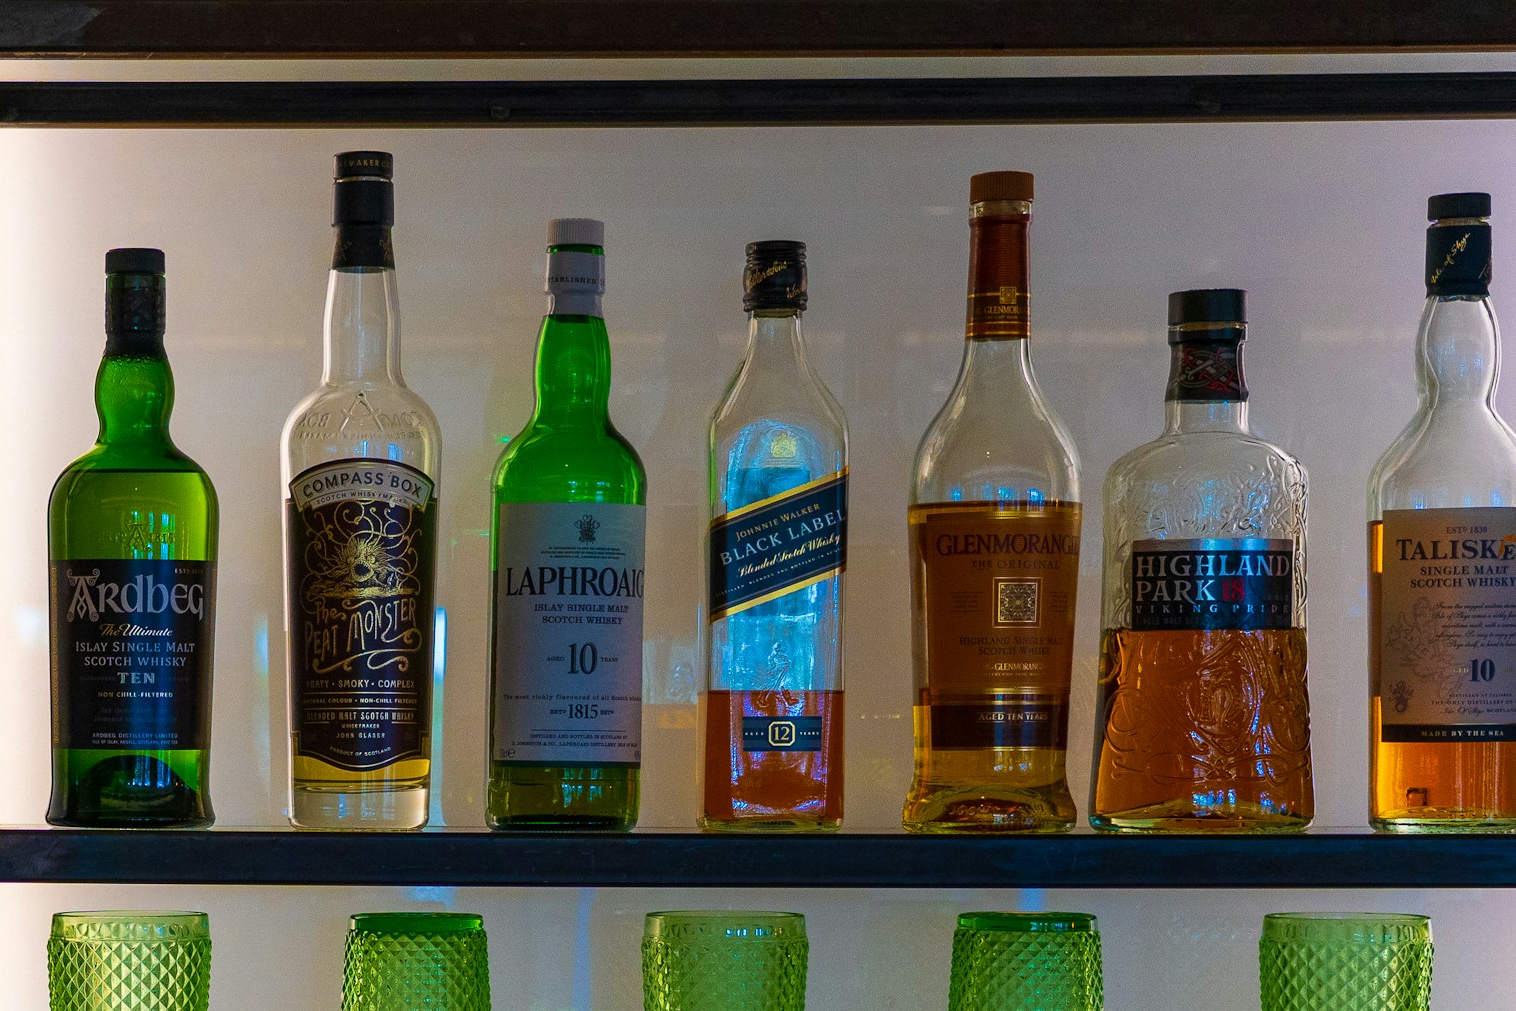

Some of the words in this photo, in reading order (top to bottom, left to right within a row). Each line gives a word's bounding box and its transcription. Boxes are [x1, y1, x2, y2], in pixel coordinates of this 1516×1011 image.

[302, 472, 383, 499] COMPASS
[390, 475, 422, 498] BOX
[736, 518, 780, 542] JOHNNIE
[780, 503, 820, 523] WALKER
[720, 532, 782, 566] BLACK
[790, 508, 846, 540] LABEL
[736, 552, 776, 578] Blended
[776, 543, 807, 566] Scotch
[806, 532, 841, 552] Whisky
[1396, 539, 1516, 561] TALISKE
[972, 560, 993, 569] THE
[997, 560, 1060, 570] ORIGINAL
[1136, 555, 1291, 577] HIGHLAND
[1420, 565, 1469, 576] SINGLE
[1474, 566, 1508, 575] MALT
[1410, 578, 1462, 589] SCOTCH
[1467, 577, 1516, 588] WHISKY
[1136, 579, 1216, 604] PARK
[1222, 580, 1246, 600] 18
[534, 604, 564, 613] ISLAY
[567, 604, 604, 613] SINGLE
[607, 604, 628, 613] MALT
[1136, 604, 1218, 614] VIKING
[1233, 604, 1290, 614] PRIDE
[542, 616, 582, 624] SCOTCH
[586, 616, 622, 625] WHISKY
[100, 623, 120, 636] The
[120, 623, 173, 637] Ultimate
[76, 641, 108, 652] ISLAY
[113, 641, 160, 652] SINGLE
[166, 642, 195, 652] MALT
[304, 621, 338, 670] PEAT
[84, 656, 132, 666] SCOTCH
[138, 656, 186, 666] WHISKY
[567, 642, 597, 674] 10
[1469, 659, 1495, 682] 10
[117, 672, 155, 684] TEN
[568, 704, 598, 719] 1815
[979, 713, 1004, 721] AGED
[1007, 713, 1023, 721] TEN
[1026, 713, 1048, 721] YEARS
